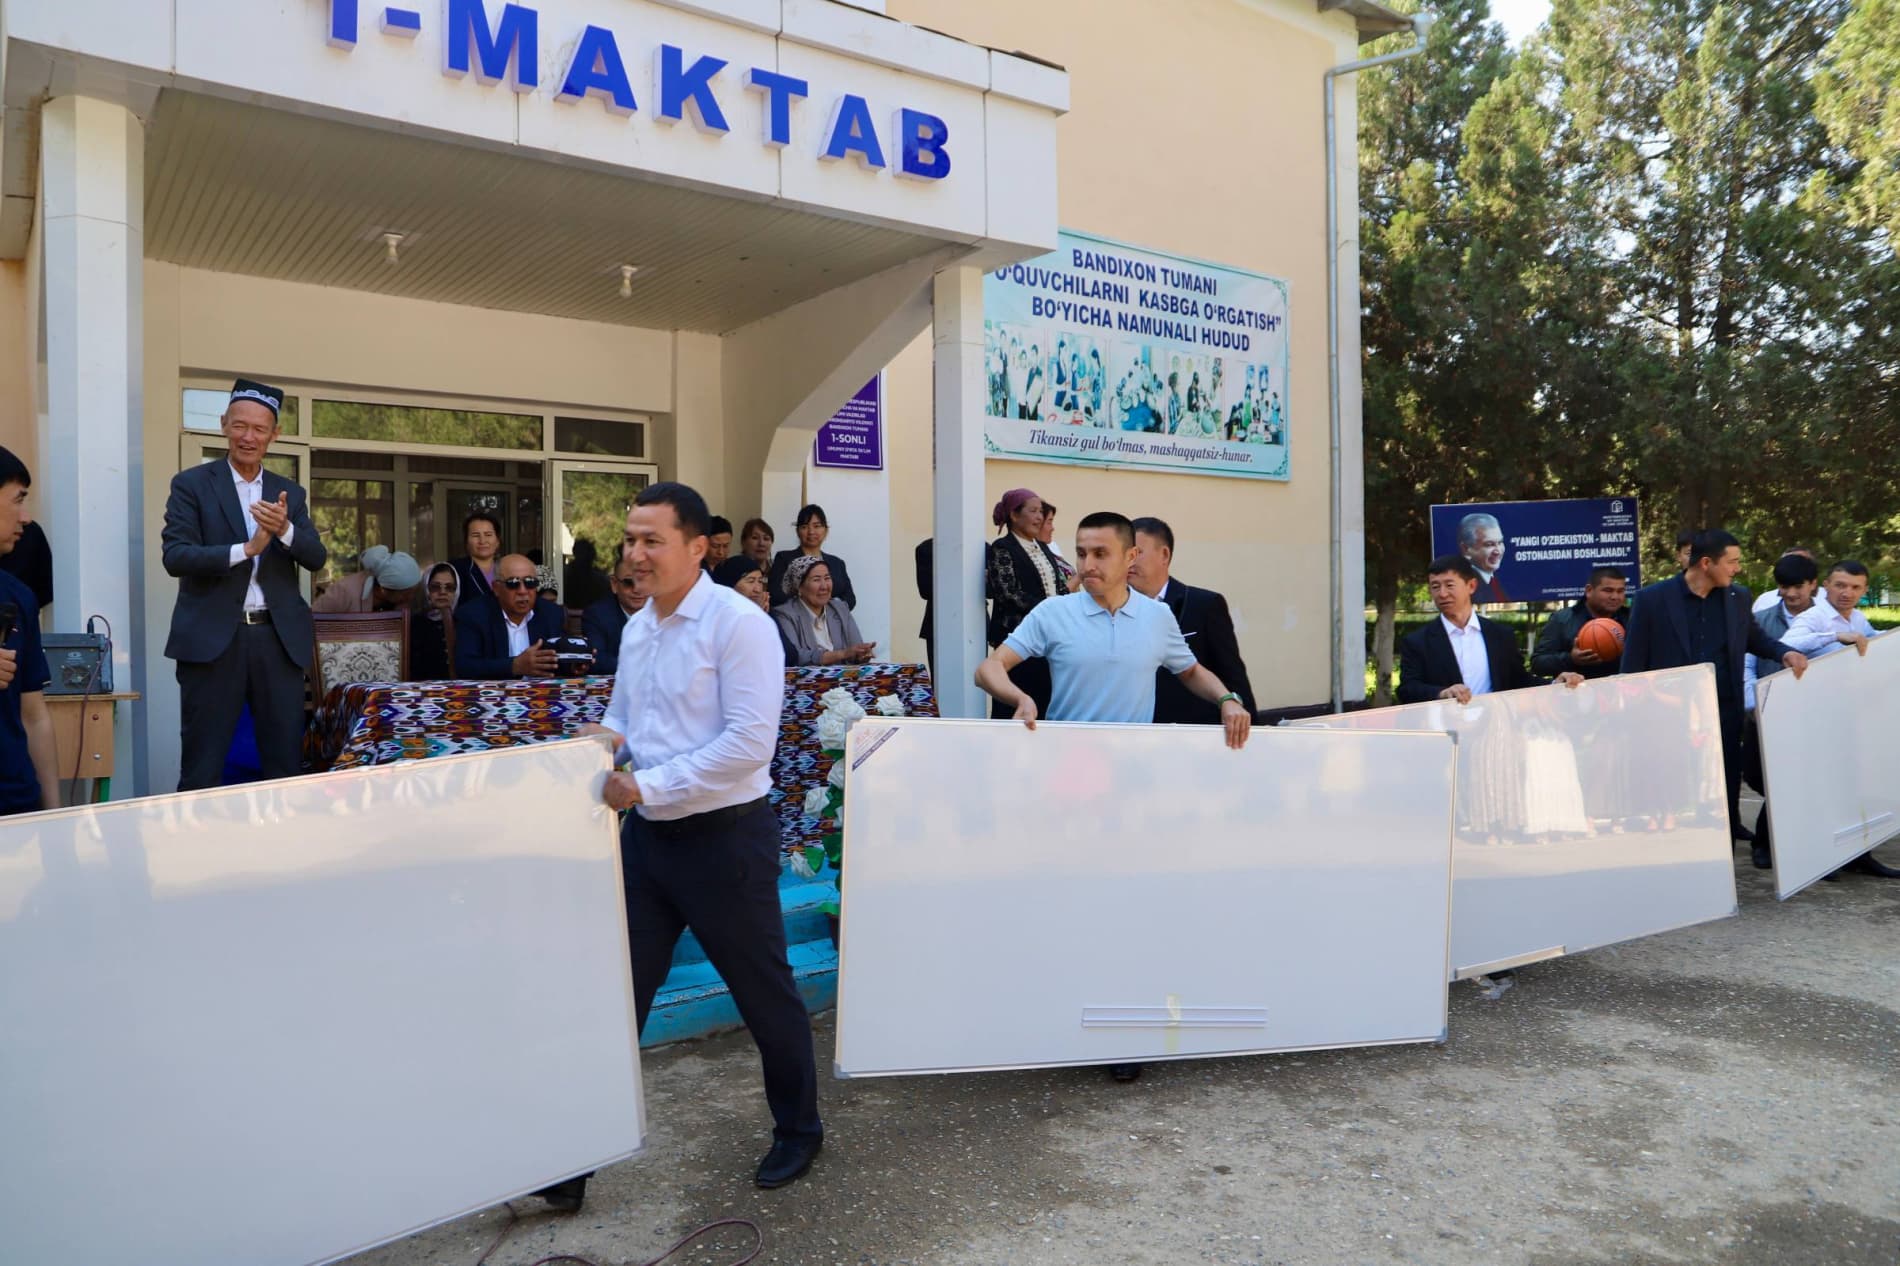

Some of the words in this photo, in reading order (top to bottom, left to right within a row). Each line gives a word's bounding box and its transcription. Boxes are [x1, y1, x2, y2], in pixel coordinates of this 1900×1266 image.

[1073, 248, 1156, 283] BANDIXON
[1161, 268, 1217, 296] TUMANI
[1139, 289, 1200, 318] KASBGA
[1032, 296, 1113, 329] BO‘YICHA
[1118, 311, 1196, 343] NAMUNALI
[1202, 327, 1250, 351] HUDUD
[831, 433, 866, 445] 1-SONLI
[1029, 429, 1079, 448] Tikansiz
[1080, 435, 1100, 451] gul
[1600, 532, 1634, 543] MAKTAB
[1515, 549, 1572, 561] OSTONASIDAN
